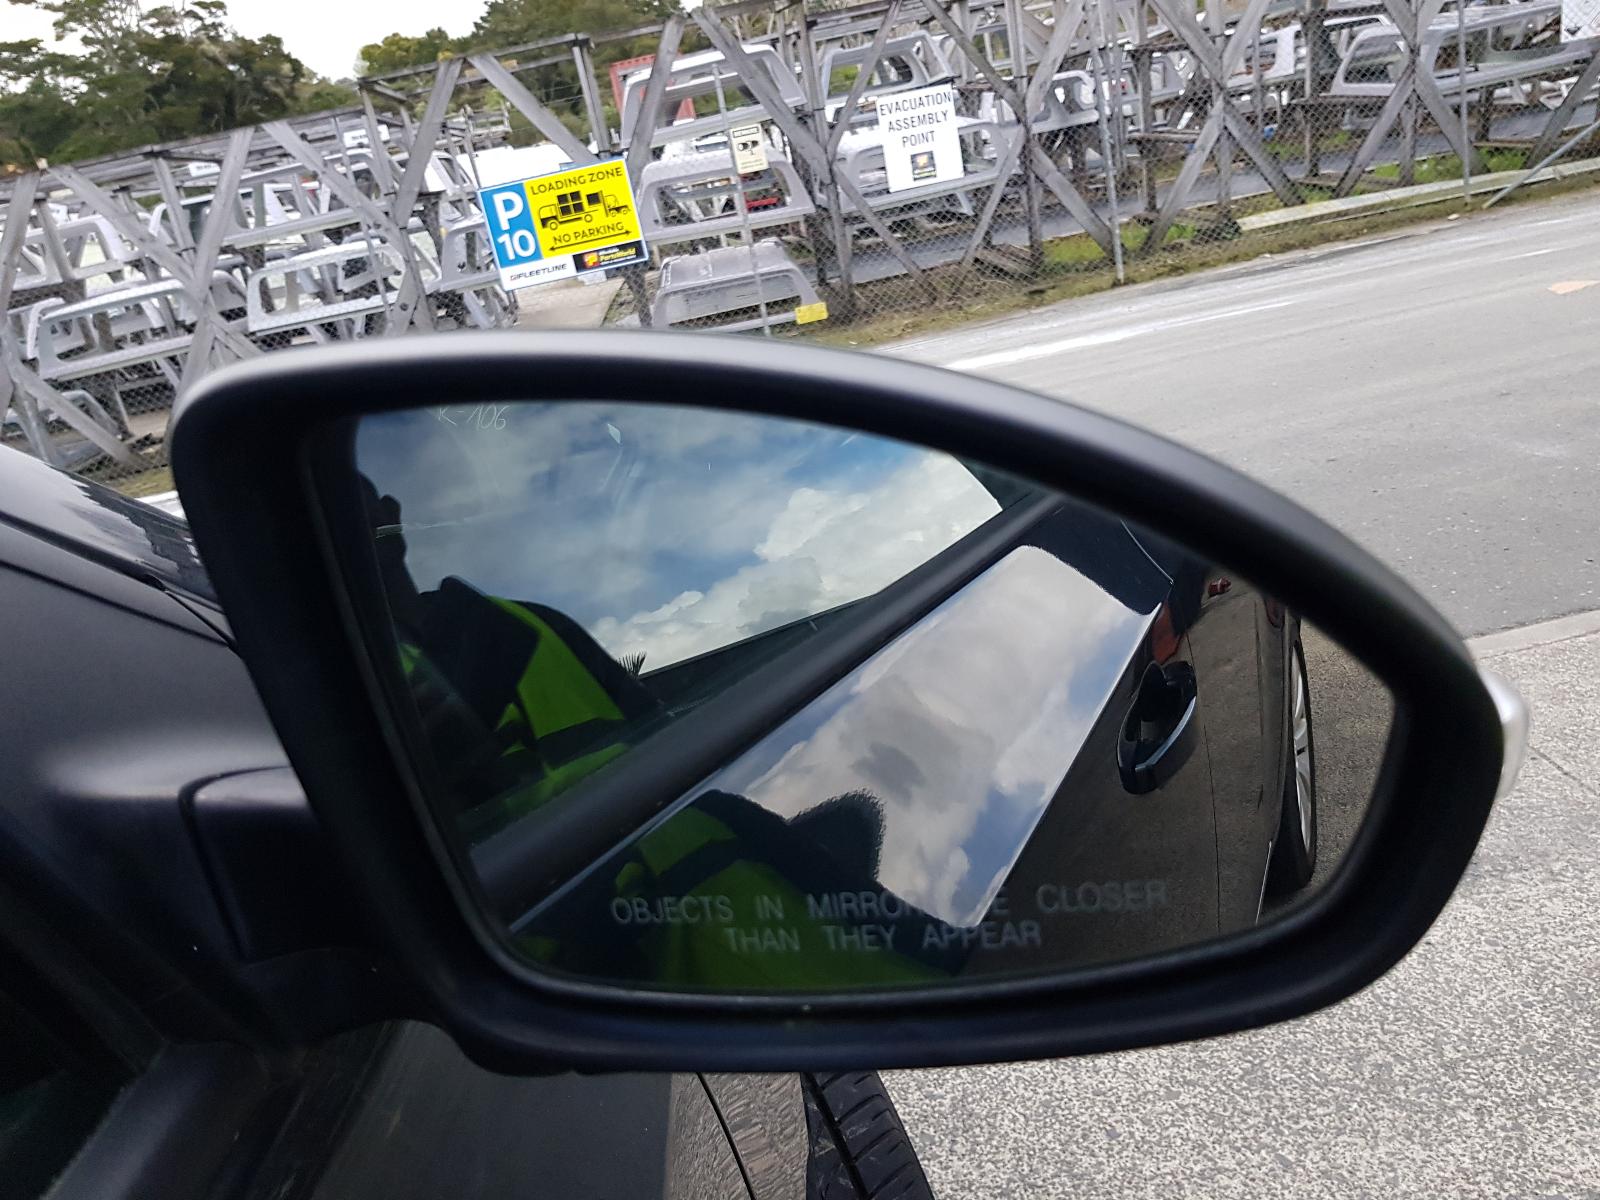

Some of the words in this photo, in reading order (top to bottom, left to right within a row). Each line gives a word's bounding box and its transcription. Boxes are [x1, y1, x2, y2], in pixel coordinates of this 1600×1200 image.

[880, 92, 951, 116] EVACUATION
[889, 110, 948, 132] ASSEMBLY
[902, 131, 936, 148] POINT
[531, 175, 587, 195] LOADING
[589, 167, 624, 183] ZONE
[493, 191, 524, 231] P
[497, 229, 536, 261] 10
[553, 234, 572, 246] NO
[574, 222, 625, 241] PARKING
[611, 896, 734, 924] OBJECTS
[756, 894, 785, 920] IN
[1036, 879, 1169, 914] CLOSER
[724, 927, 801, 953] THAN
[821, 924, 895, 951] THEY
[922, 919, 1042, 950] APPEAR
